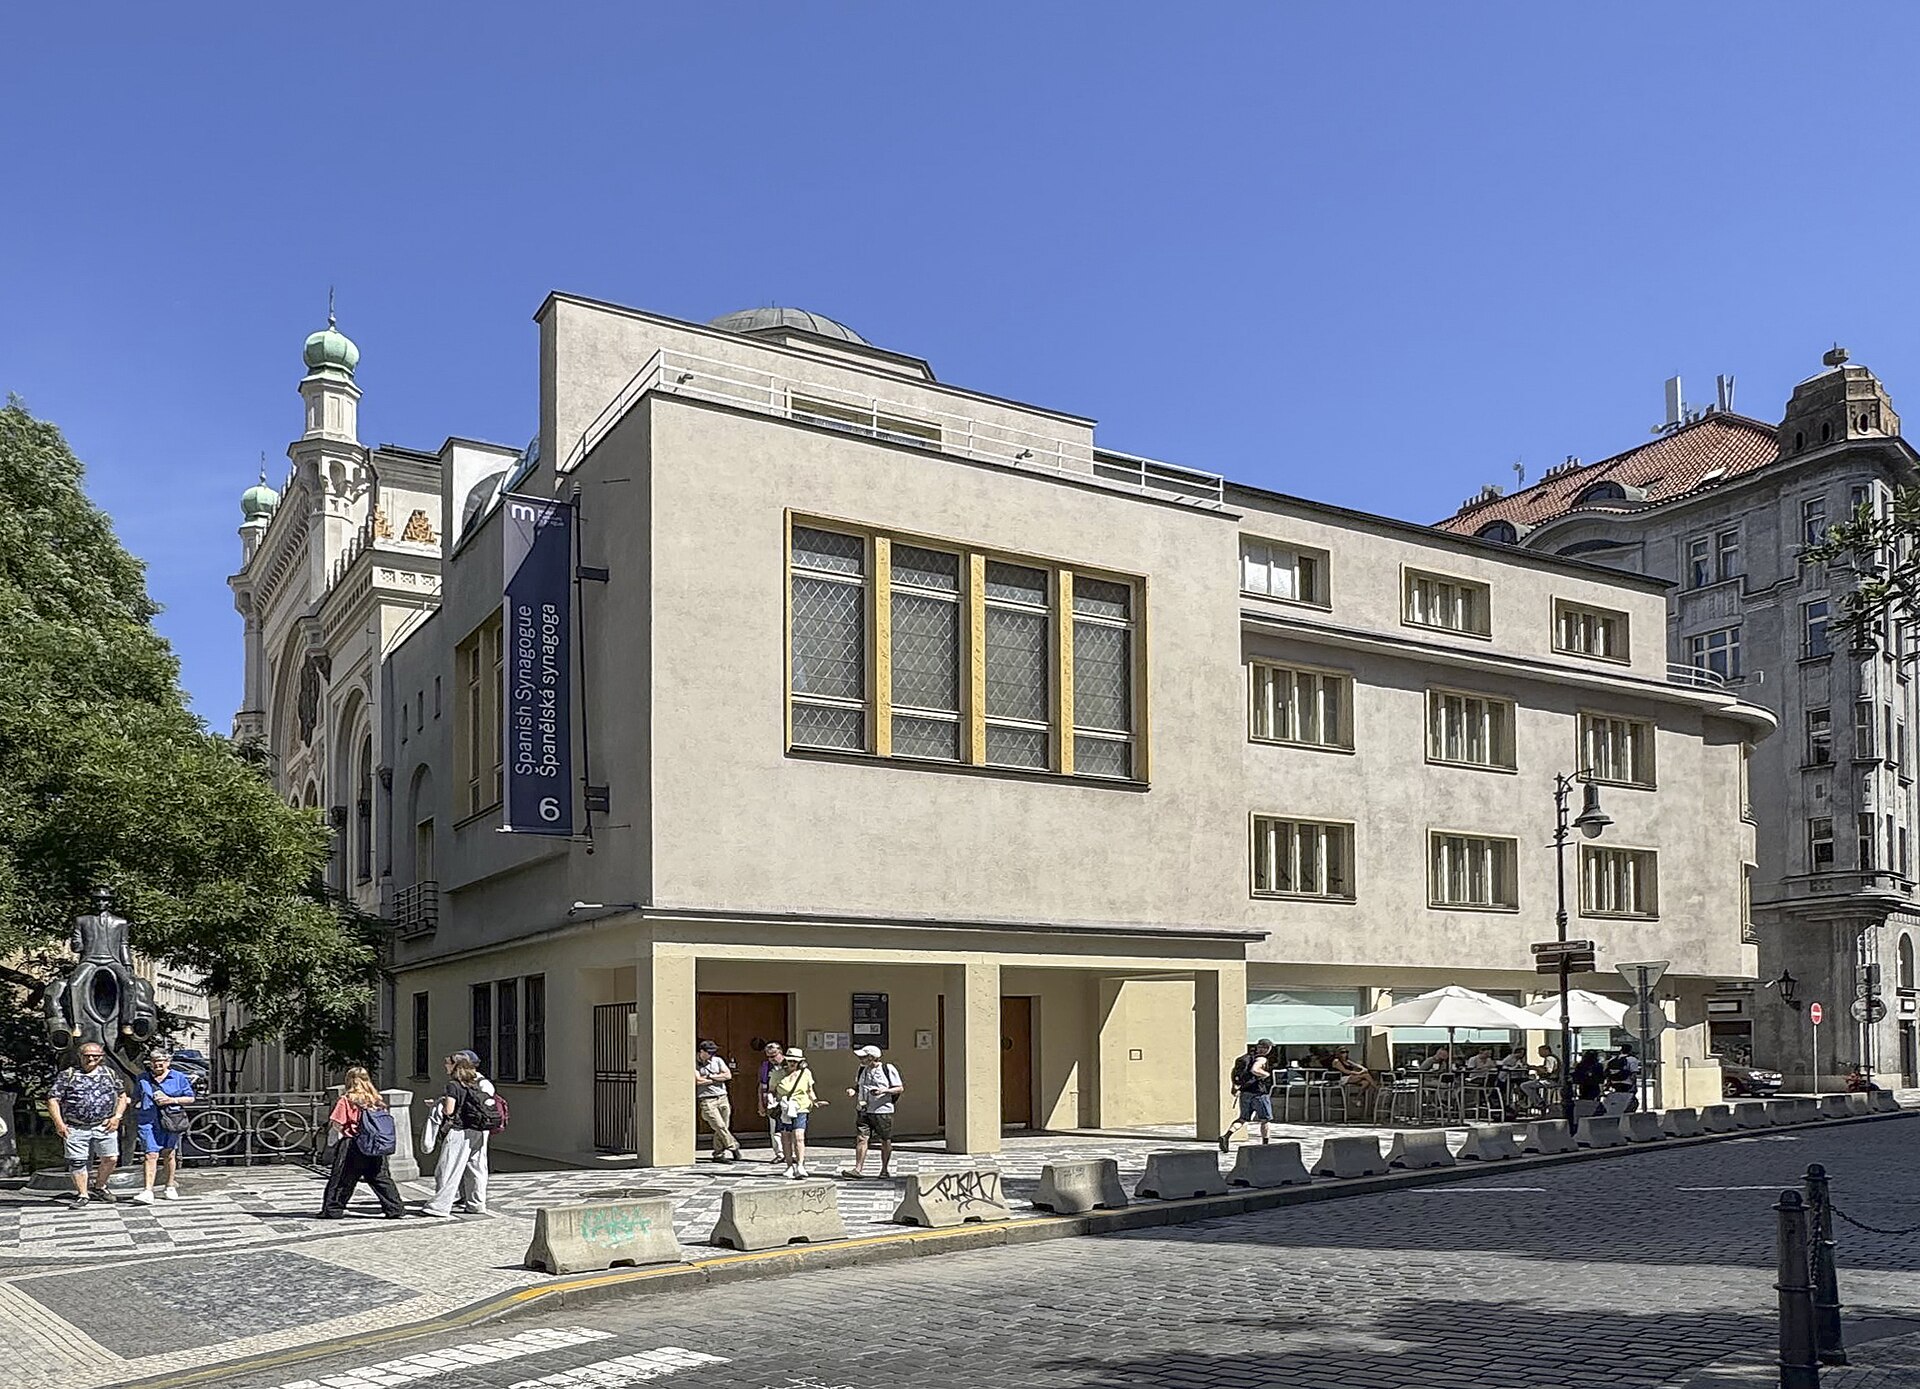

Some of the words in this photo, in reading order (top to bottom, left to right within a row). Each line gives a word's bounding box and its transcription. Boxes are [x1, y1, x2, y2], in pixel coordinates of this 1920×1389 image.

[515, 605, 536, 701] Synagogue
[542, 604, 560, 685] synagoga
[515, 705, 536, 776] Spanish
[534, 690, 560, 777] Španělská
[539, 797, 560, 822] 6
